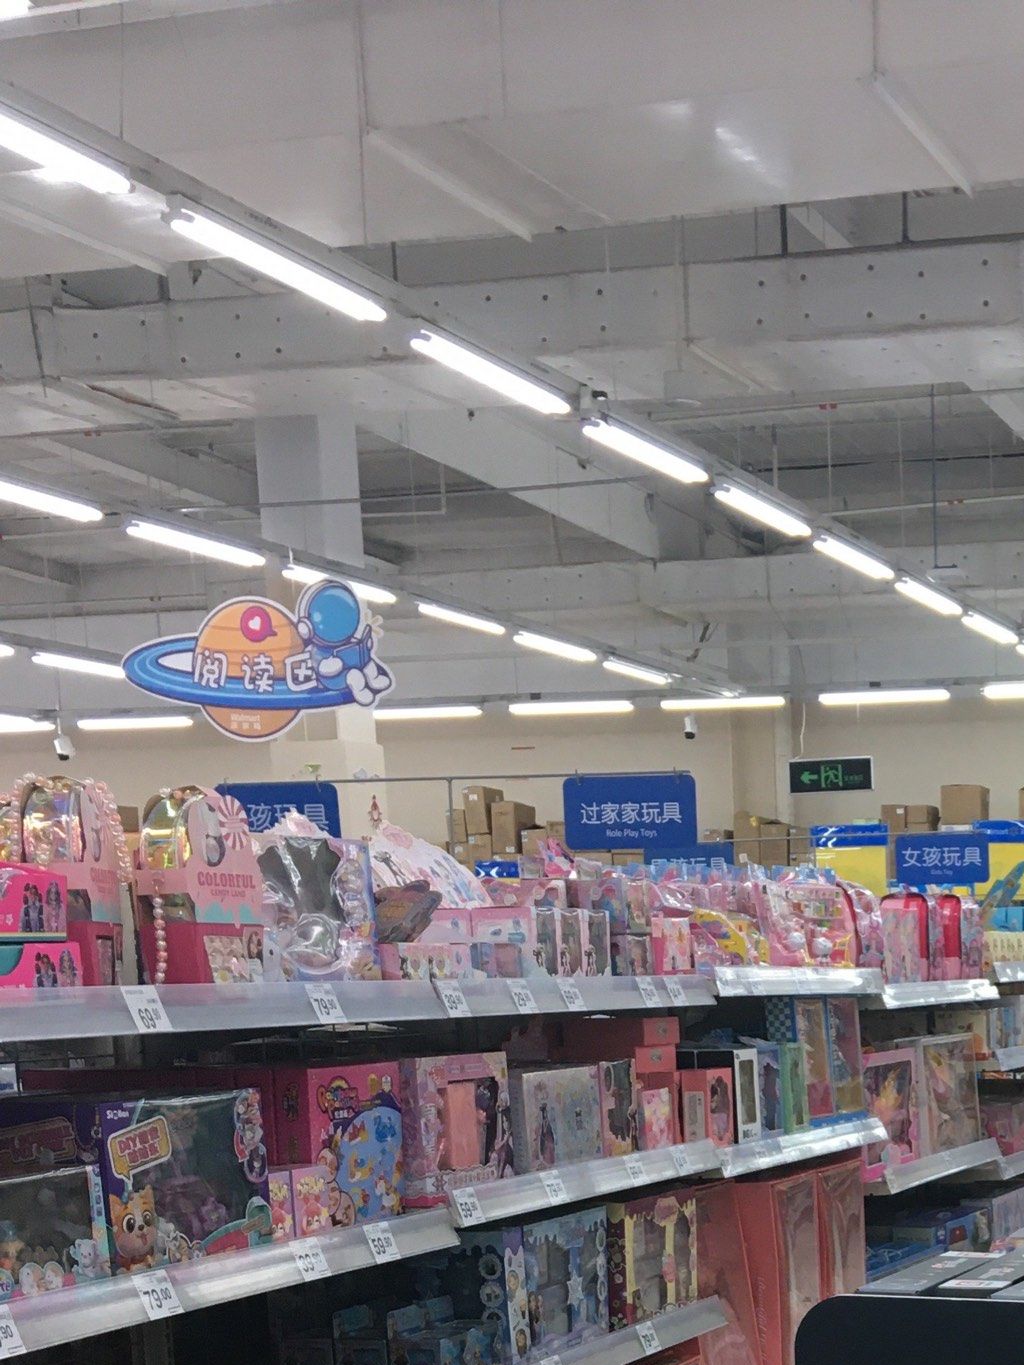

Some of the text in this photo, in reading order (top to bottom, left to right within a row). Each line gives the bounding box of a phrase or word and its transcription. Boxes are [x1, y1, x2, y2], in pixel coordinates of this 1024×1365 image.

[194, 650, 317, 693] 阅读区
[580, 801, 682, 825] 过家家玩具
[606, 828, 657, 838] Role Play Toys
[901, 846, 982, 867] 女孩玩具
[197, 871, 256, 889] COLORFUL
[143, 1287, 172, 1311] 79.00
